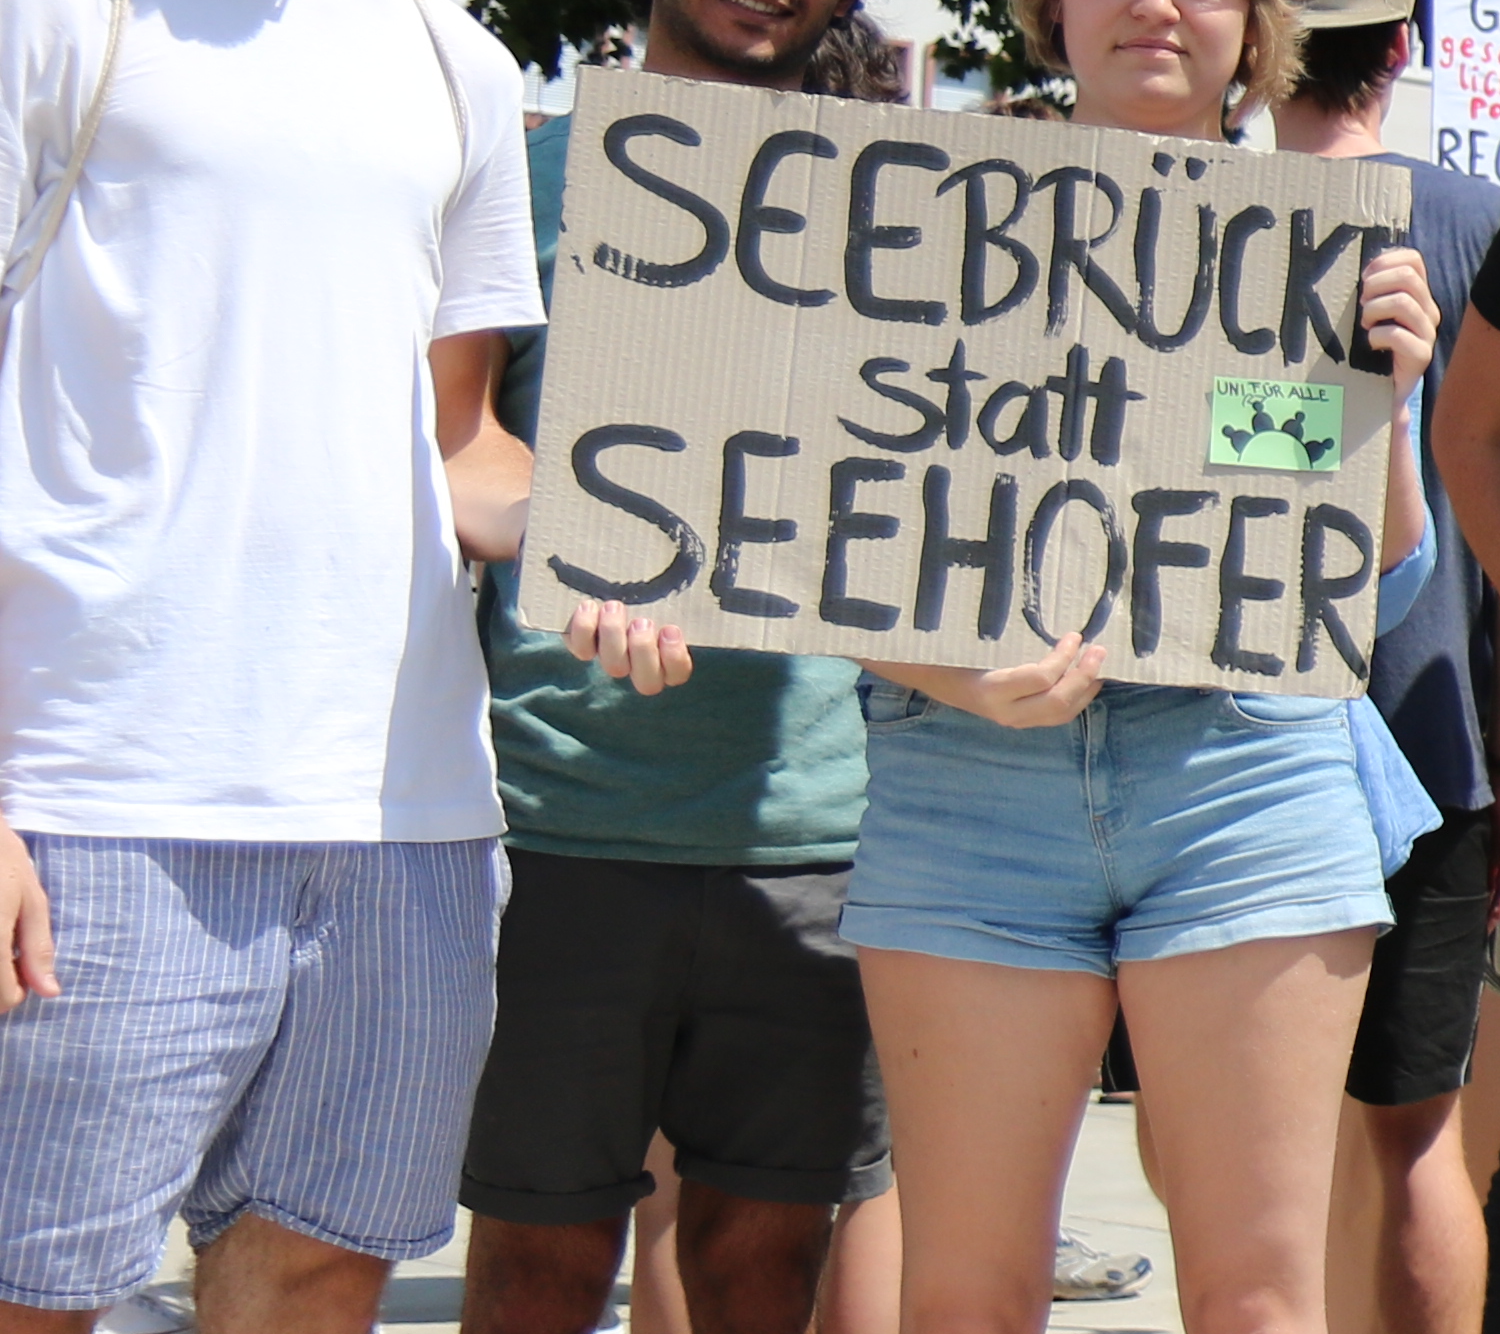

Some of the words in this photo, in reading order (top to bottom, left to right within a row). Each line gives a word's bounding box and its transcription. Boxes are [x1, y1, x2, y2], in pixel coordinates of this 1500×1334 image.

[1217, 379, 1245, 396] UNI
[1247, 381, 1284, 398] FÜR
[1288, 387, 1329, 402] ALLE
[547, 421, 1374, 681] SEEHOFER
